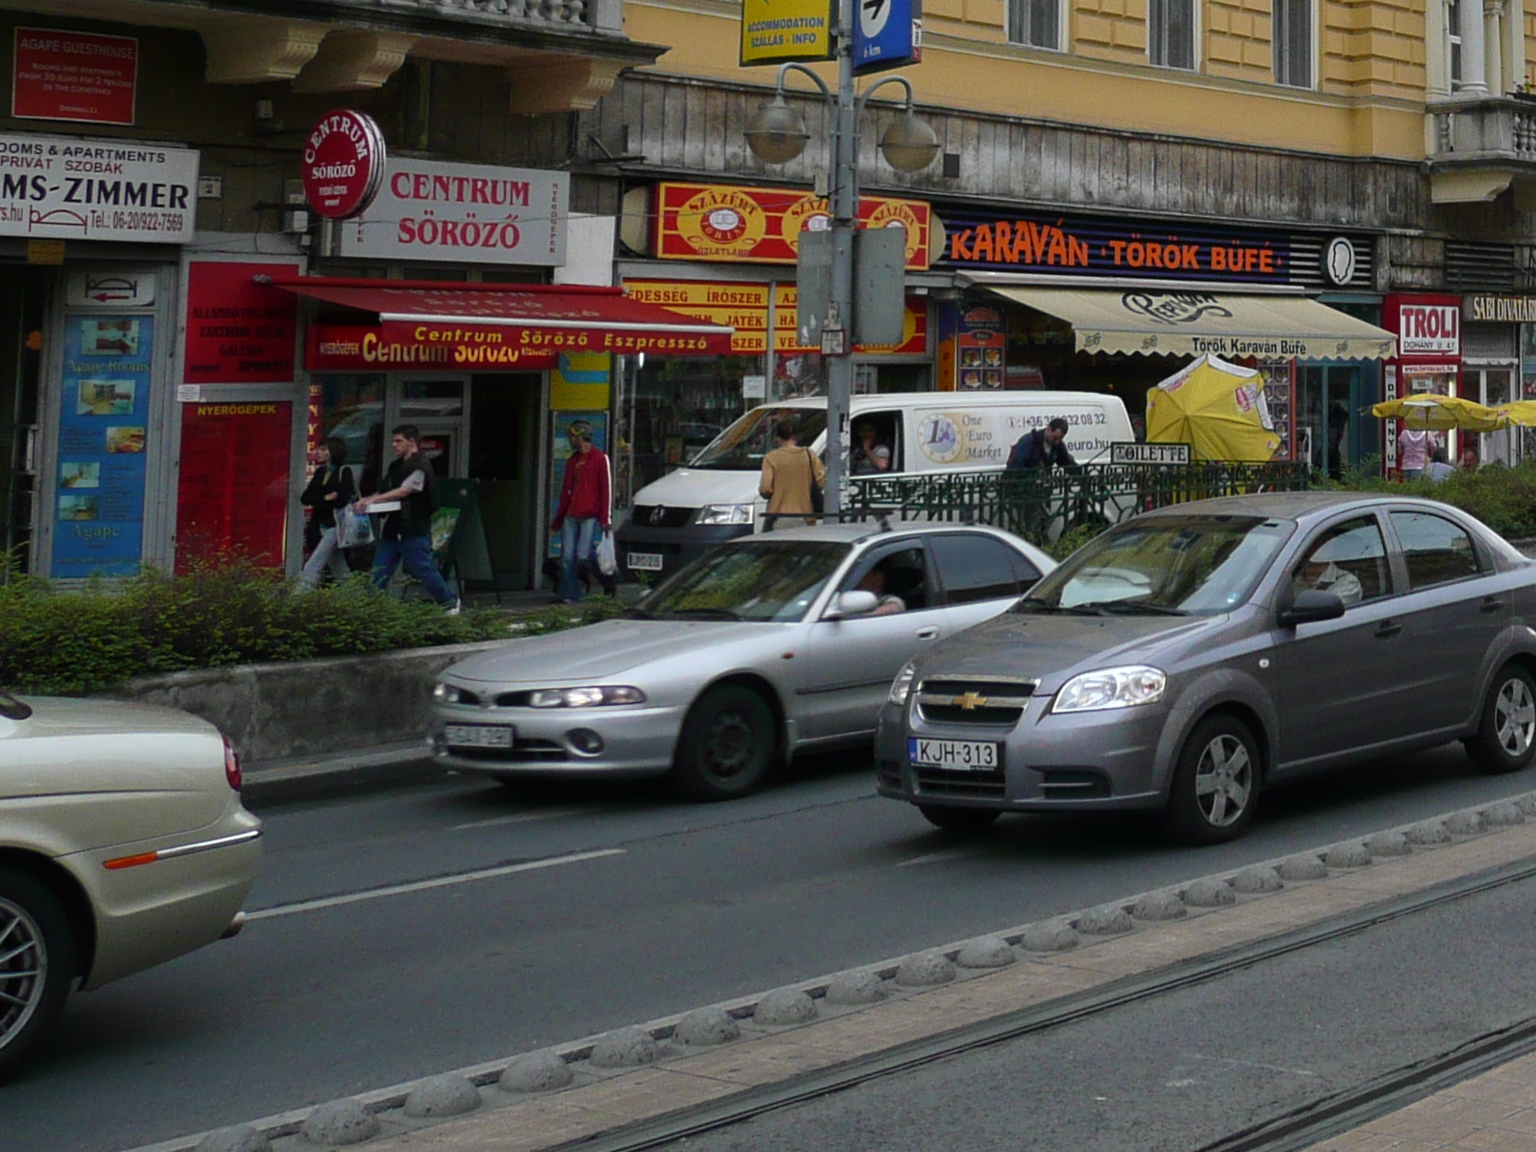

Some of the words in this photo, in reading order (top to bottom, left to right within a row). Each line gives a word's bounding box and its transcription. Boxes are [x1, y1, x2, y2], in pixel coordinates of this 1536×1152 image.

[747, 17, 825, 33] ACCOMMODATION
[20, 38, 60, 52] AGAPE
[63, 40, 134, 60] GUESTHOUSE
[751, 32, 784, 48] SZÁLLÁS
[792, 33, 817, 44] INFO
[869, 44, 881, 57] km
[304, 116, 368, 164] CENTRUM
[48, 144, 59, 156] &
[63, 146, 166, 164] APARTMENTS
[64, 160, 124, 175] SZOBÁK
[390, 172, 531, 207] CENTRUM
[688, 190, 758, 216] SZÁZÉRT
[397, 208, 521, 250] SÖRÖZŐ
[949, 216, 1089, 268] KARAVÁN
[1108, 233, 1200, 270] TÖRÖK
[1210, 239, 1274, 274] BÜFÉ
[706, 287, 762, 304] ÍRÓSZER
[1473, 296, 1496, 321] SABI
[724, 311, 763, 328] JÁTÉK
[1401, 308, 1457, 339] TROLI
[414, 326, 503, 344] Centrum
[519, 328, 589, 347] Söröző
[603, 333, 709, 351] Eszpresszó
[1191, 336, 1227, 355] Török
[1230, 338, 1278, 355] Karaván
[1280, 338, 1307, 356] Büfé
[1403, 339, 1434, 350] DOHÁNY
[962, 414, 983, 427] One
[1081, 414, 1093, 426] 08
[1094, 413, 1106, 425] 32
[966, 430, 993, 442] Euro
[965, 446, 1001, 461] Market
[1115, 446, 1187, 462] TOILETTE
[920, 741, 993, 765] KJH-313
